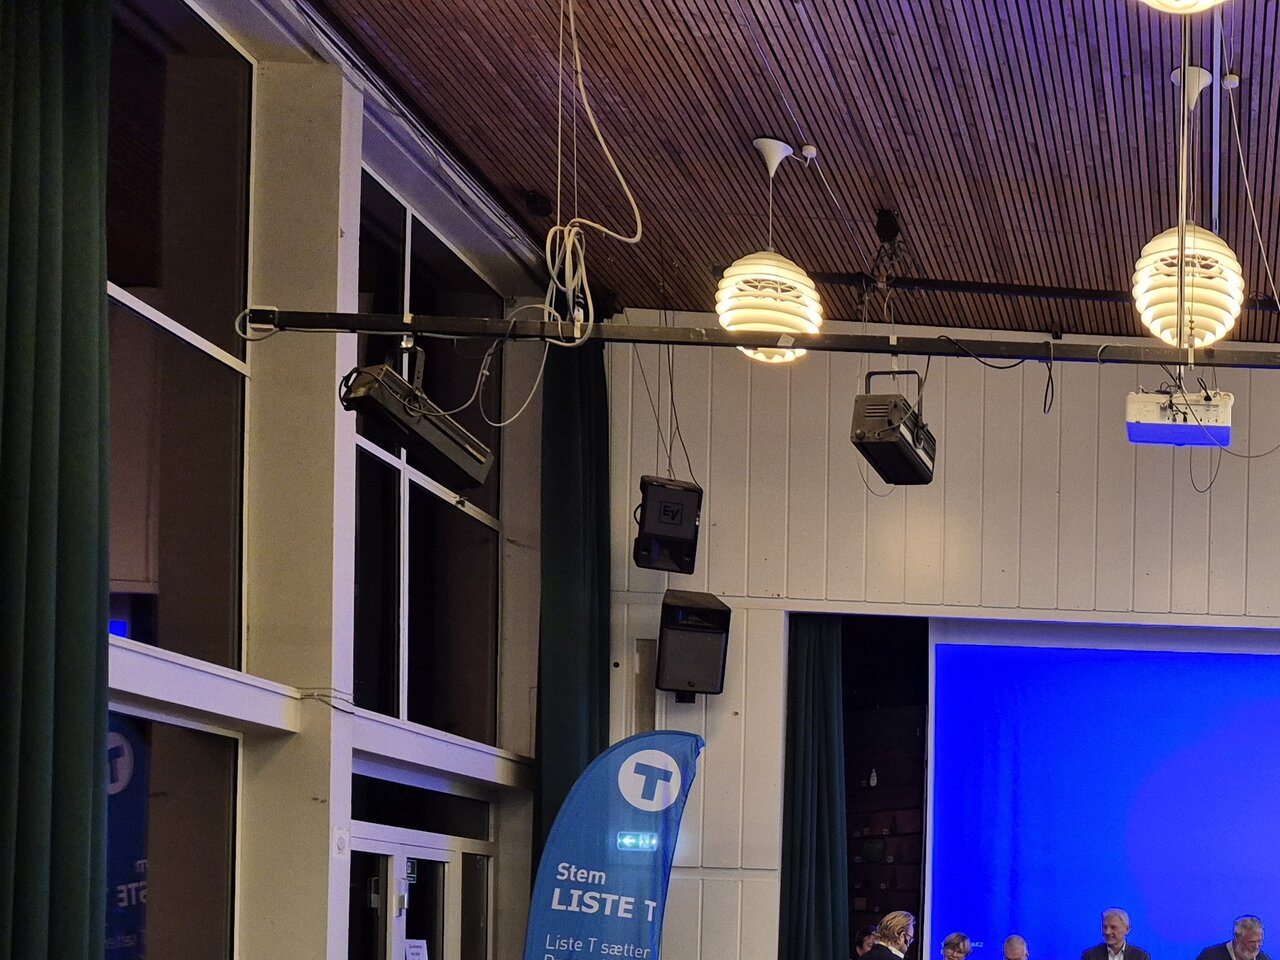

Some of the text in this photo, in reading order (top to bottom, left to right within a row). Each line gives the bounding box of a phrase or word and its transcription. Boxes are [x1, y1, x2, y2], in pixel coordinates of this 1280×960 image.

[633, 762, 673, 802] T
[556, 862, 606, 885] Stem
[551, 887, 657, 922] LISTE T
[545, 934, 651, 958] Liste T sætter
